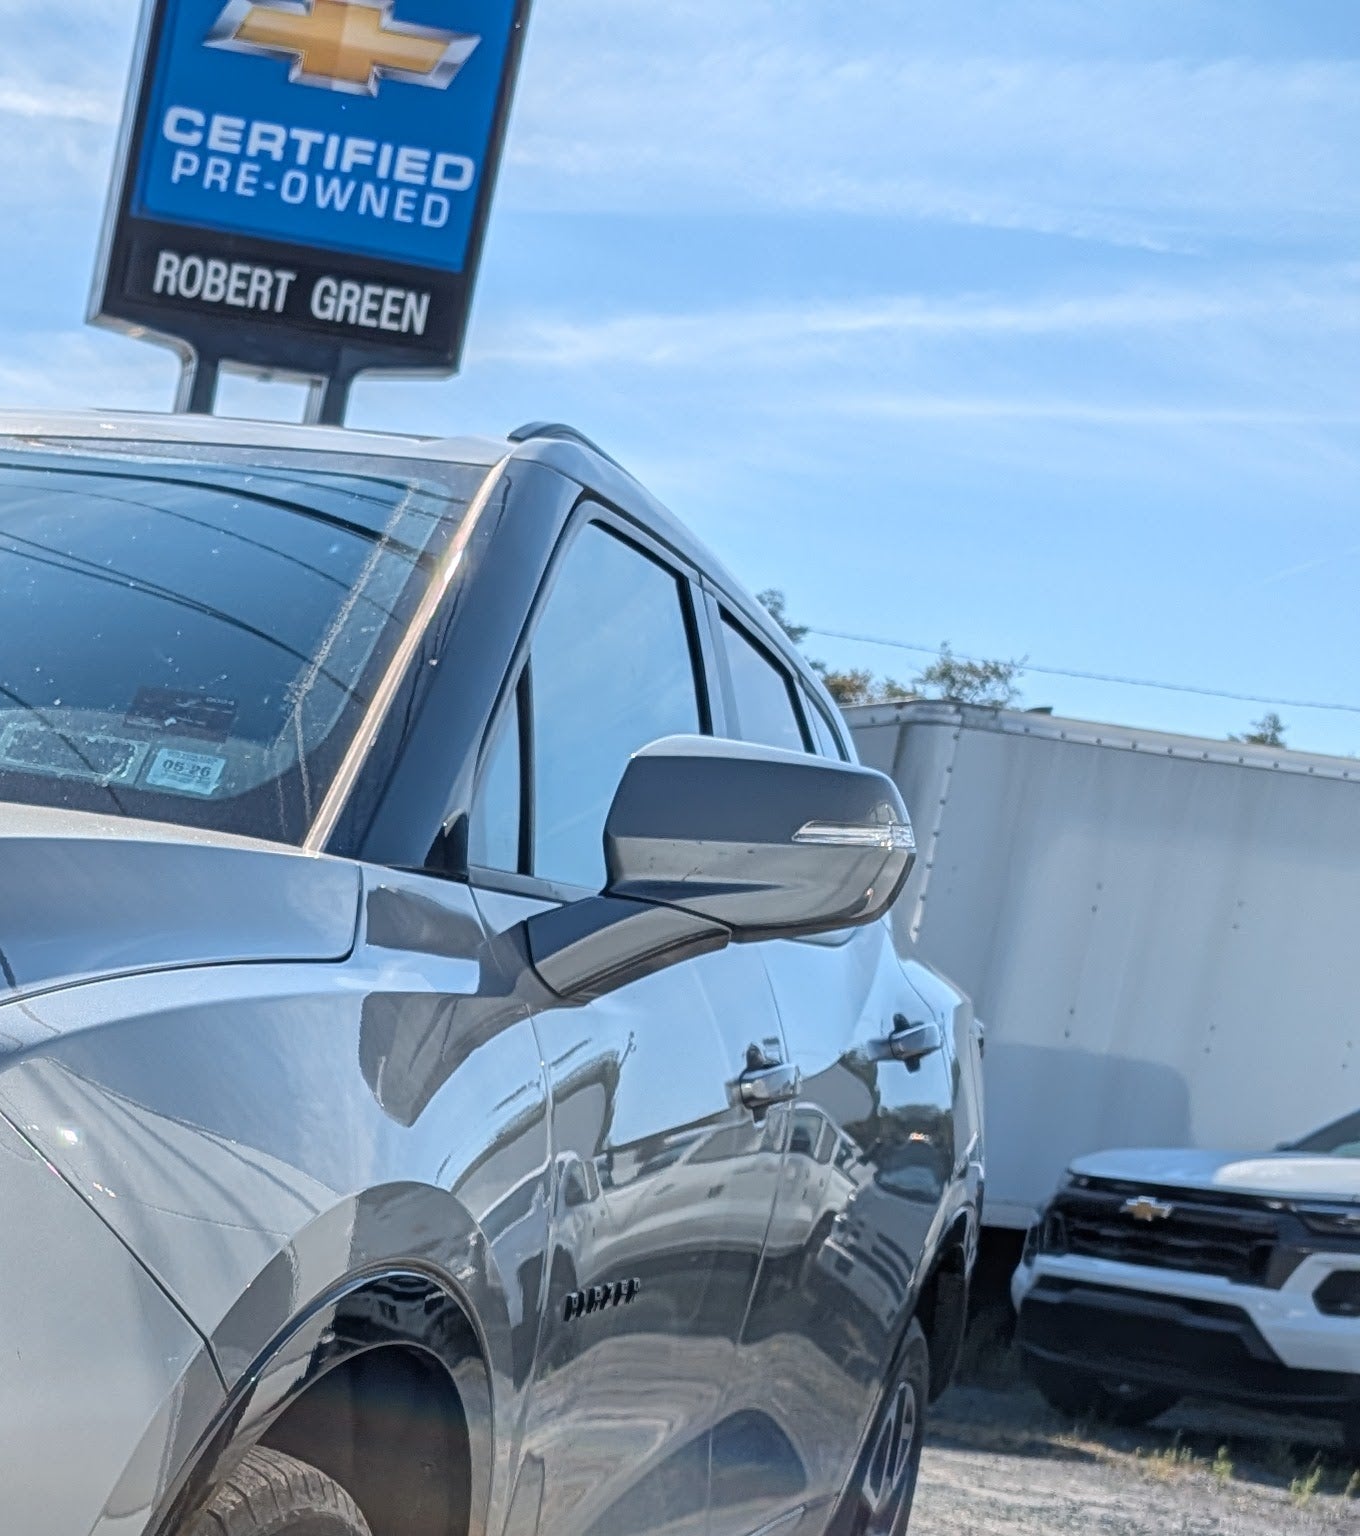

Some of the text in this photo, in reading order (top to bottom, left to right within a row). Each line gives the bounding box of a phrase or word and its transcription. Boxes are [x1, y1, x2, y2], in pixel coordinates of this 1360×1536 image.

[162, 106, 476, 192] CERTIFIED
[170, 150, 451, 229] PRE-OWNED
[153, 250, 431, 336] ROBERT GREEN
